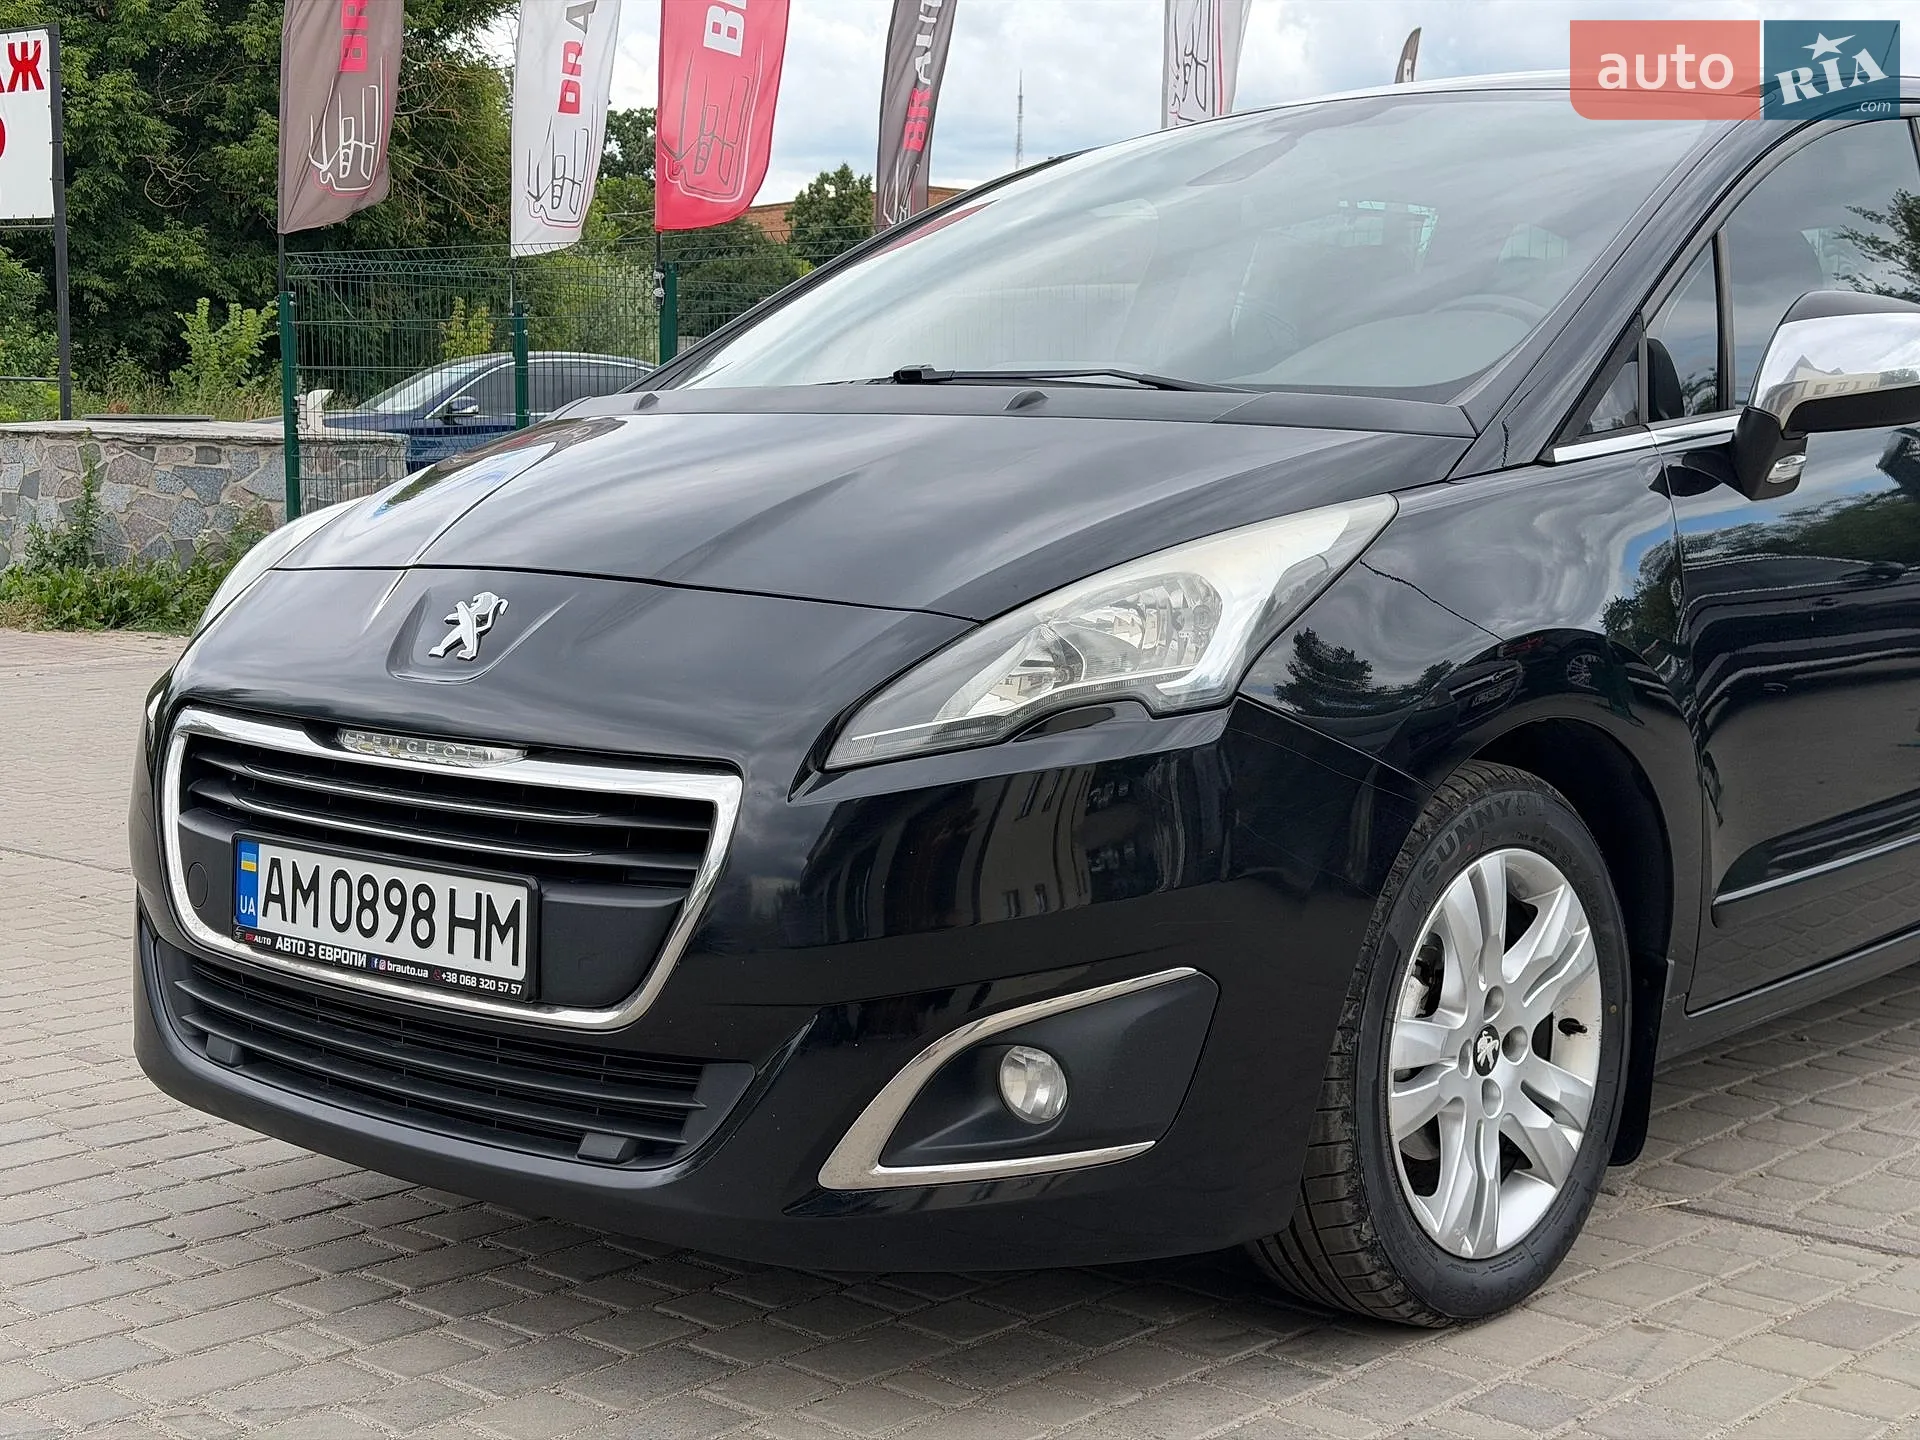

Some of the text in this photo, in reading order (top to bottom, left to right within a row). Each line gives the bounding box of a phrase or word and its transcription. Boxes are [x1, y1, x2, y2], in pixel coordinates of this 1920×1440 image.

[703, 0, 747, 57] B
[0, 40, 45, 93] Ж
[240, 894, 256, 917] UA
[262, 857, 521, 967] AM 0898 HM
[275, 936, 306, 956] АВТО
[387, 960, 429, 979] brauto.ua
[441, 971, 523, 996] +38 068 320 57 57
